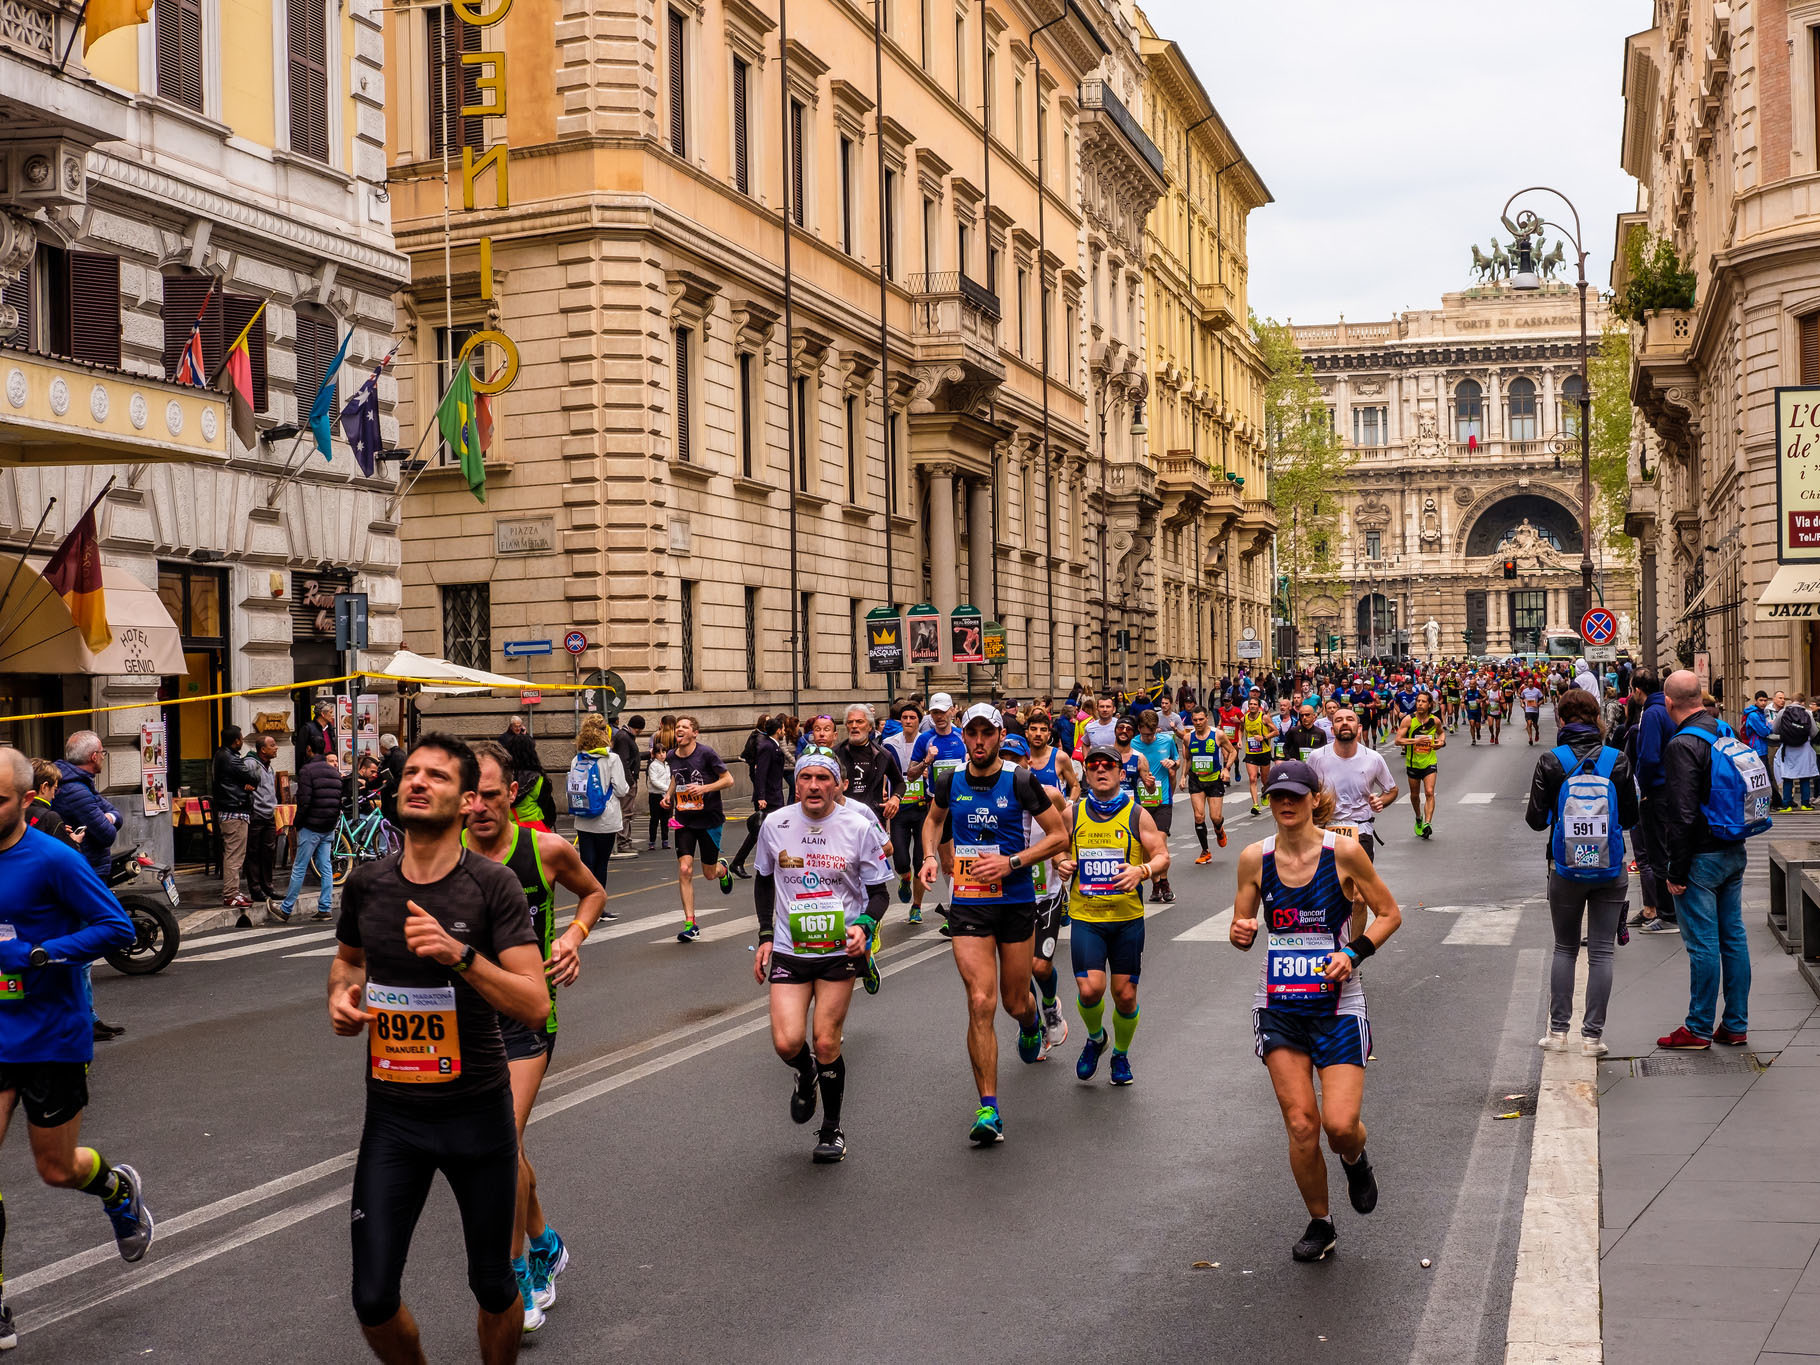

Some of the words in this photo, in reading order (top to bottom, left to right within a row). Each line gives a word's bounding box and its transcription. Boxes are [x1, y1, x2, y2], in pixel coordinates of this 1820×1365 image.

[1455, 319, 1491, 330] CORTE
[1498, 318, 1509, 328] DI
[1795, 515, 1811, 528] Via
[510, 525, 539, 536] PIAZZA
[1768, 604, 1812, 617] JAZZ
[119, 628, 149, 648] HOTEL
[869, 648, 903, 658] BASQUIAT
[911, 649, 938, 658] Boldini
[124, 659, 156, 673] GENIO
[1573, 822, 1594, 836] 591
[801, 837, 826, 846] ALAIN
[806, 852, 845, 863] MARATHON
[1080, 849, 1102, 857] acea
[833, 861, 846, 870] KM
[1084, 860, 1120, 876] 6908
[790, 902, 818, 911] acea
[1299, 908, 1326, 917] Bancari
[798, 914, 835, 933] 1667
[1299, 915, 1326, 924] Romani
[1270, 937, 1303, 946] acea
[368, 989, 409, 1006] acea
[412, 992, 453, 1000] MARATONA
[377, 1012, 446, 1041] 8926
[385, 1045, 425, 1054] EMANUELE
